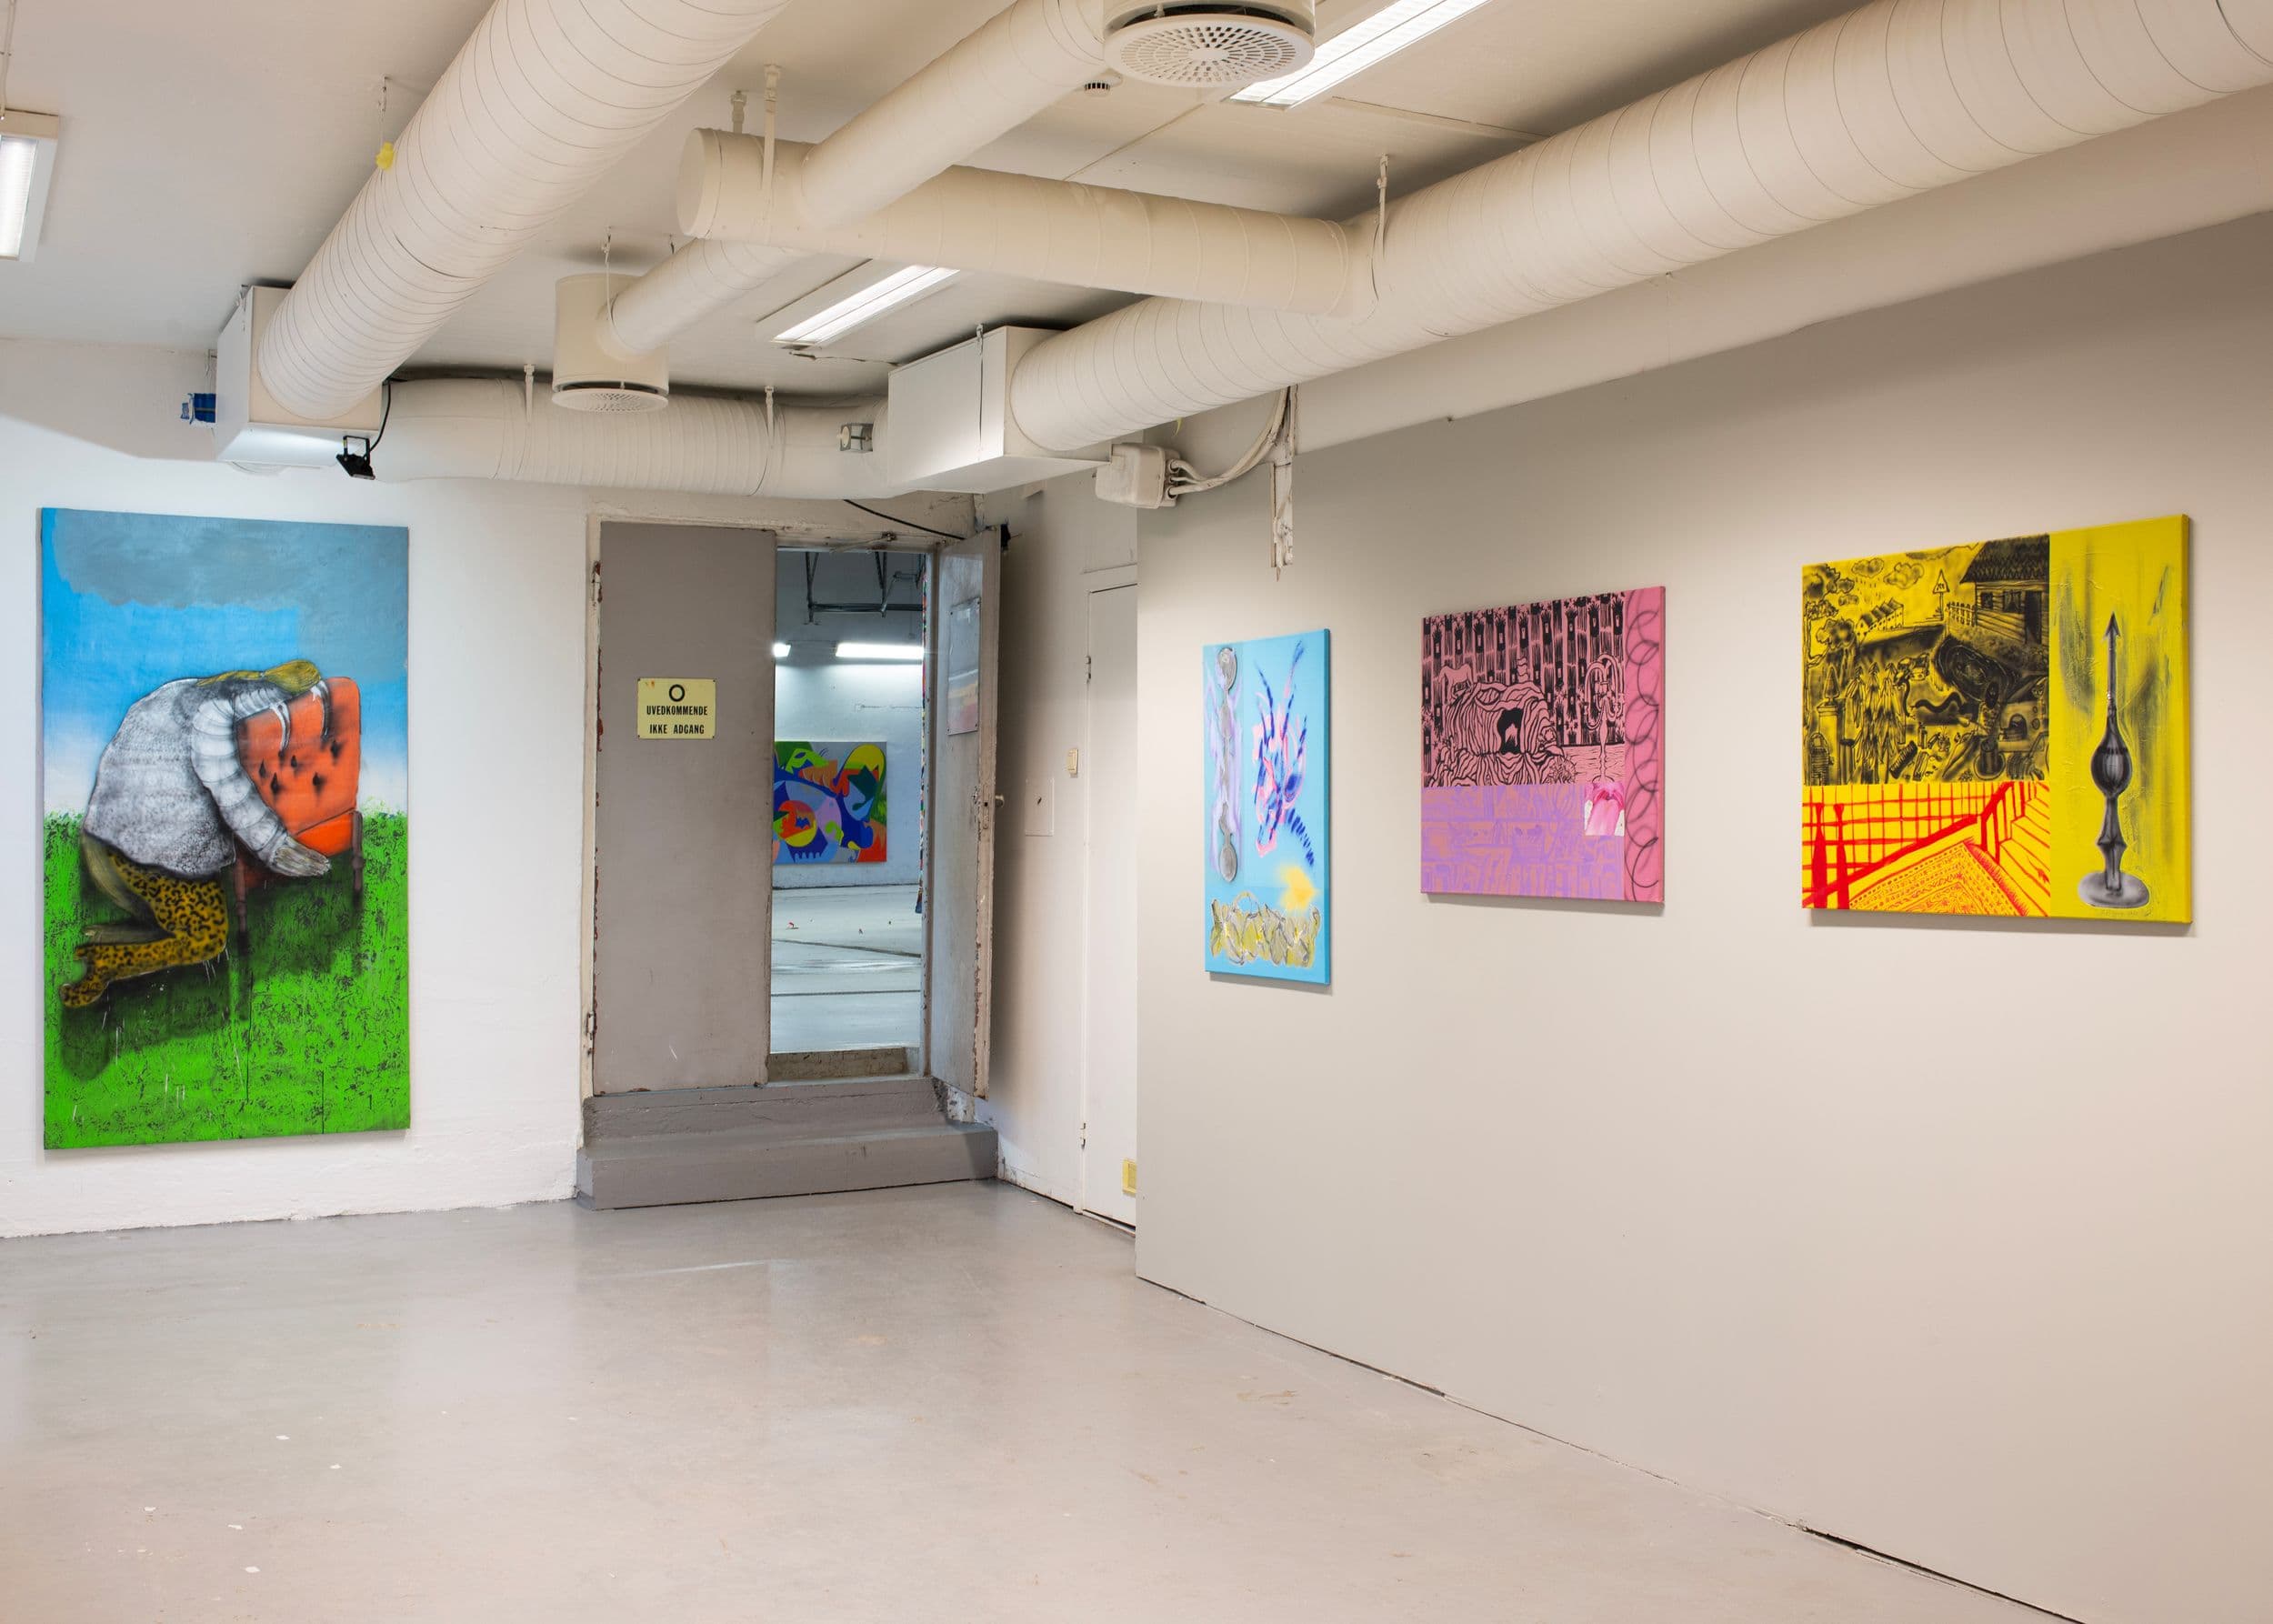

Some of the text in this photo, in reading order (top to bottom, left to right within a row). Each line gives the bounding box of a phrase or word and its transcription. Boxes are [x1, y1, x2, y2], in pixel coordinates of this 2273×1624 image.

[646, 706, 707, 716] UVEDKOMMENDE
[649, 724, 705, 734] IKKE ADGANG
